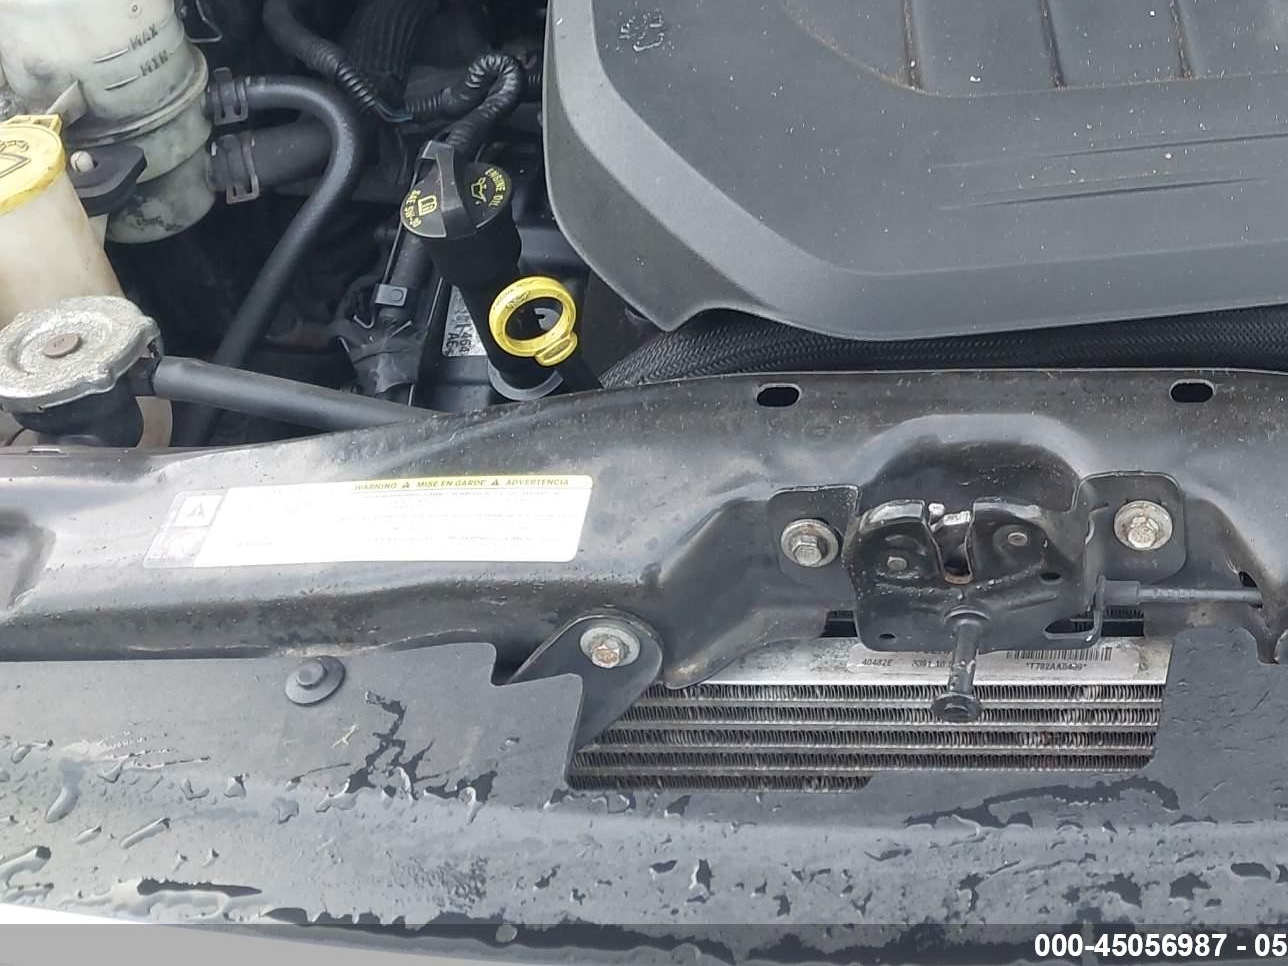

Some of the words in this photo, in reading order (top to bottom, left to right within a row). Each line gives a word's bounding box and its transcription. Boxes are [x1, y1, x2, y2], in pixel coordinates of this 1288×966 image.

[485, 168, 506, 192] ENGINE
[488, 194, 504, 207] OIL
[354, 482, 397, 491] WARNING
[416, 480, 438, 488] MISE
[455, 479, 486, 487] GARDE
[505, 478, 569, 486] ADVERTENCIA
